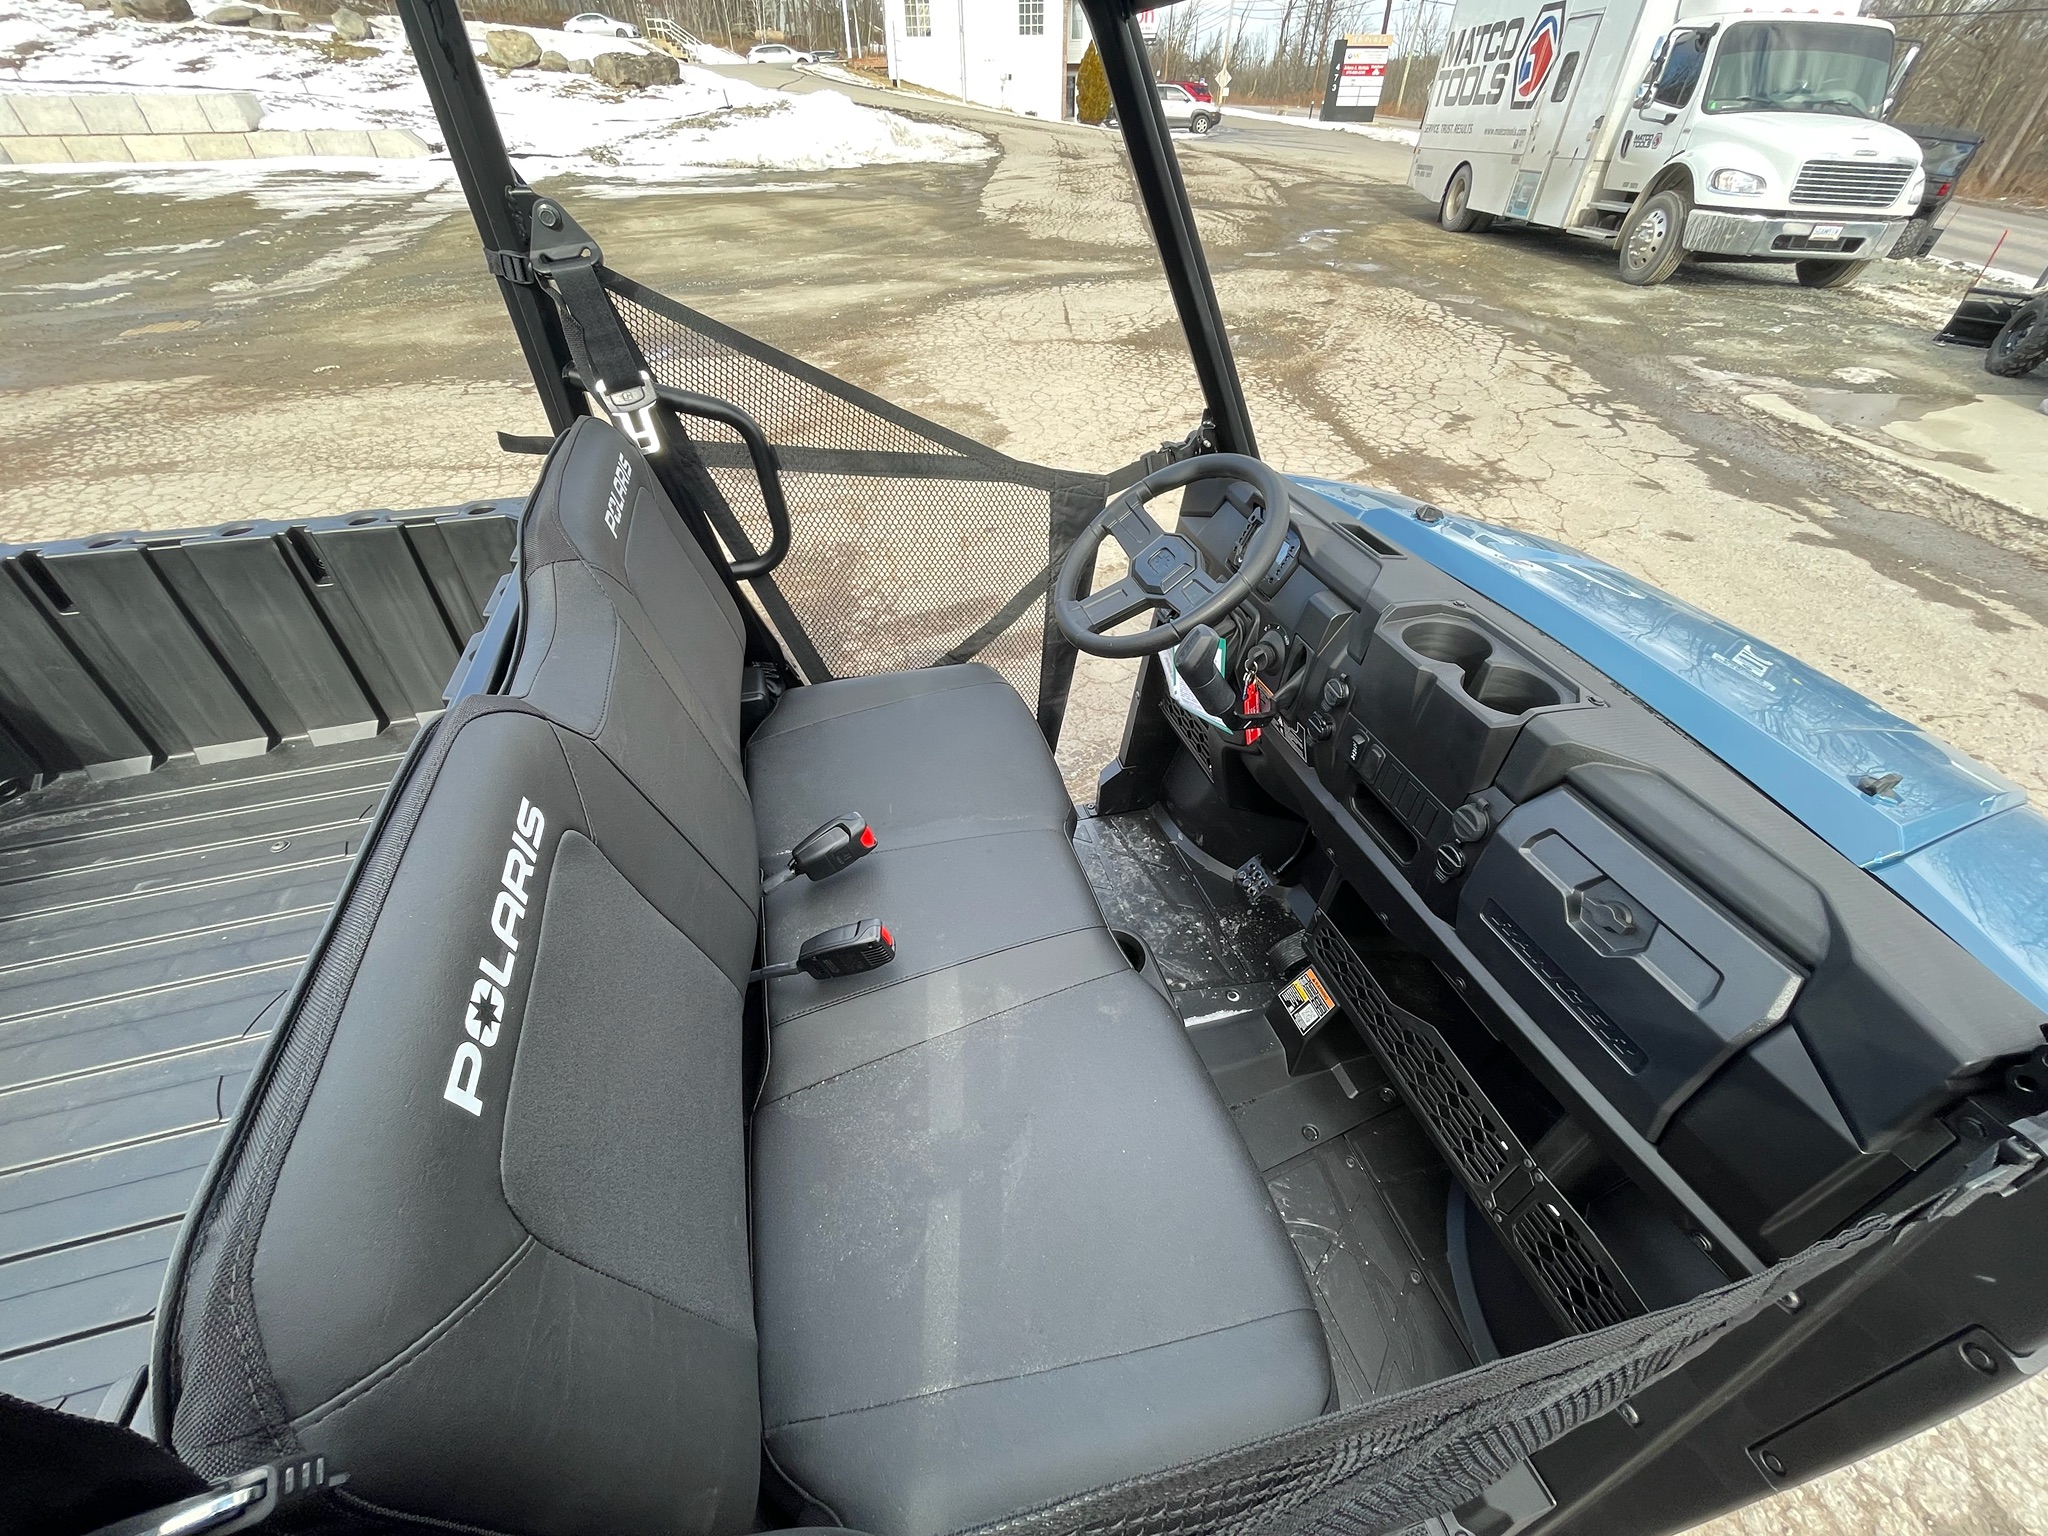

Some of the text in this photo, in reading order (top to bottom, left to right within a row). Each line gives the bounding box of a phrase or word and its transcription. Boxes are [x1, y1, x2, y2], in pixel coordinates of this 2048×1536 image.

[1442, 17, 1525, 68] MATCO
[1435, 63, 1510, 107] TOOLS
[604, 451, 632, 539] POLARIS
[443, 796, 545, 1117] POLARIS
